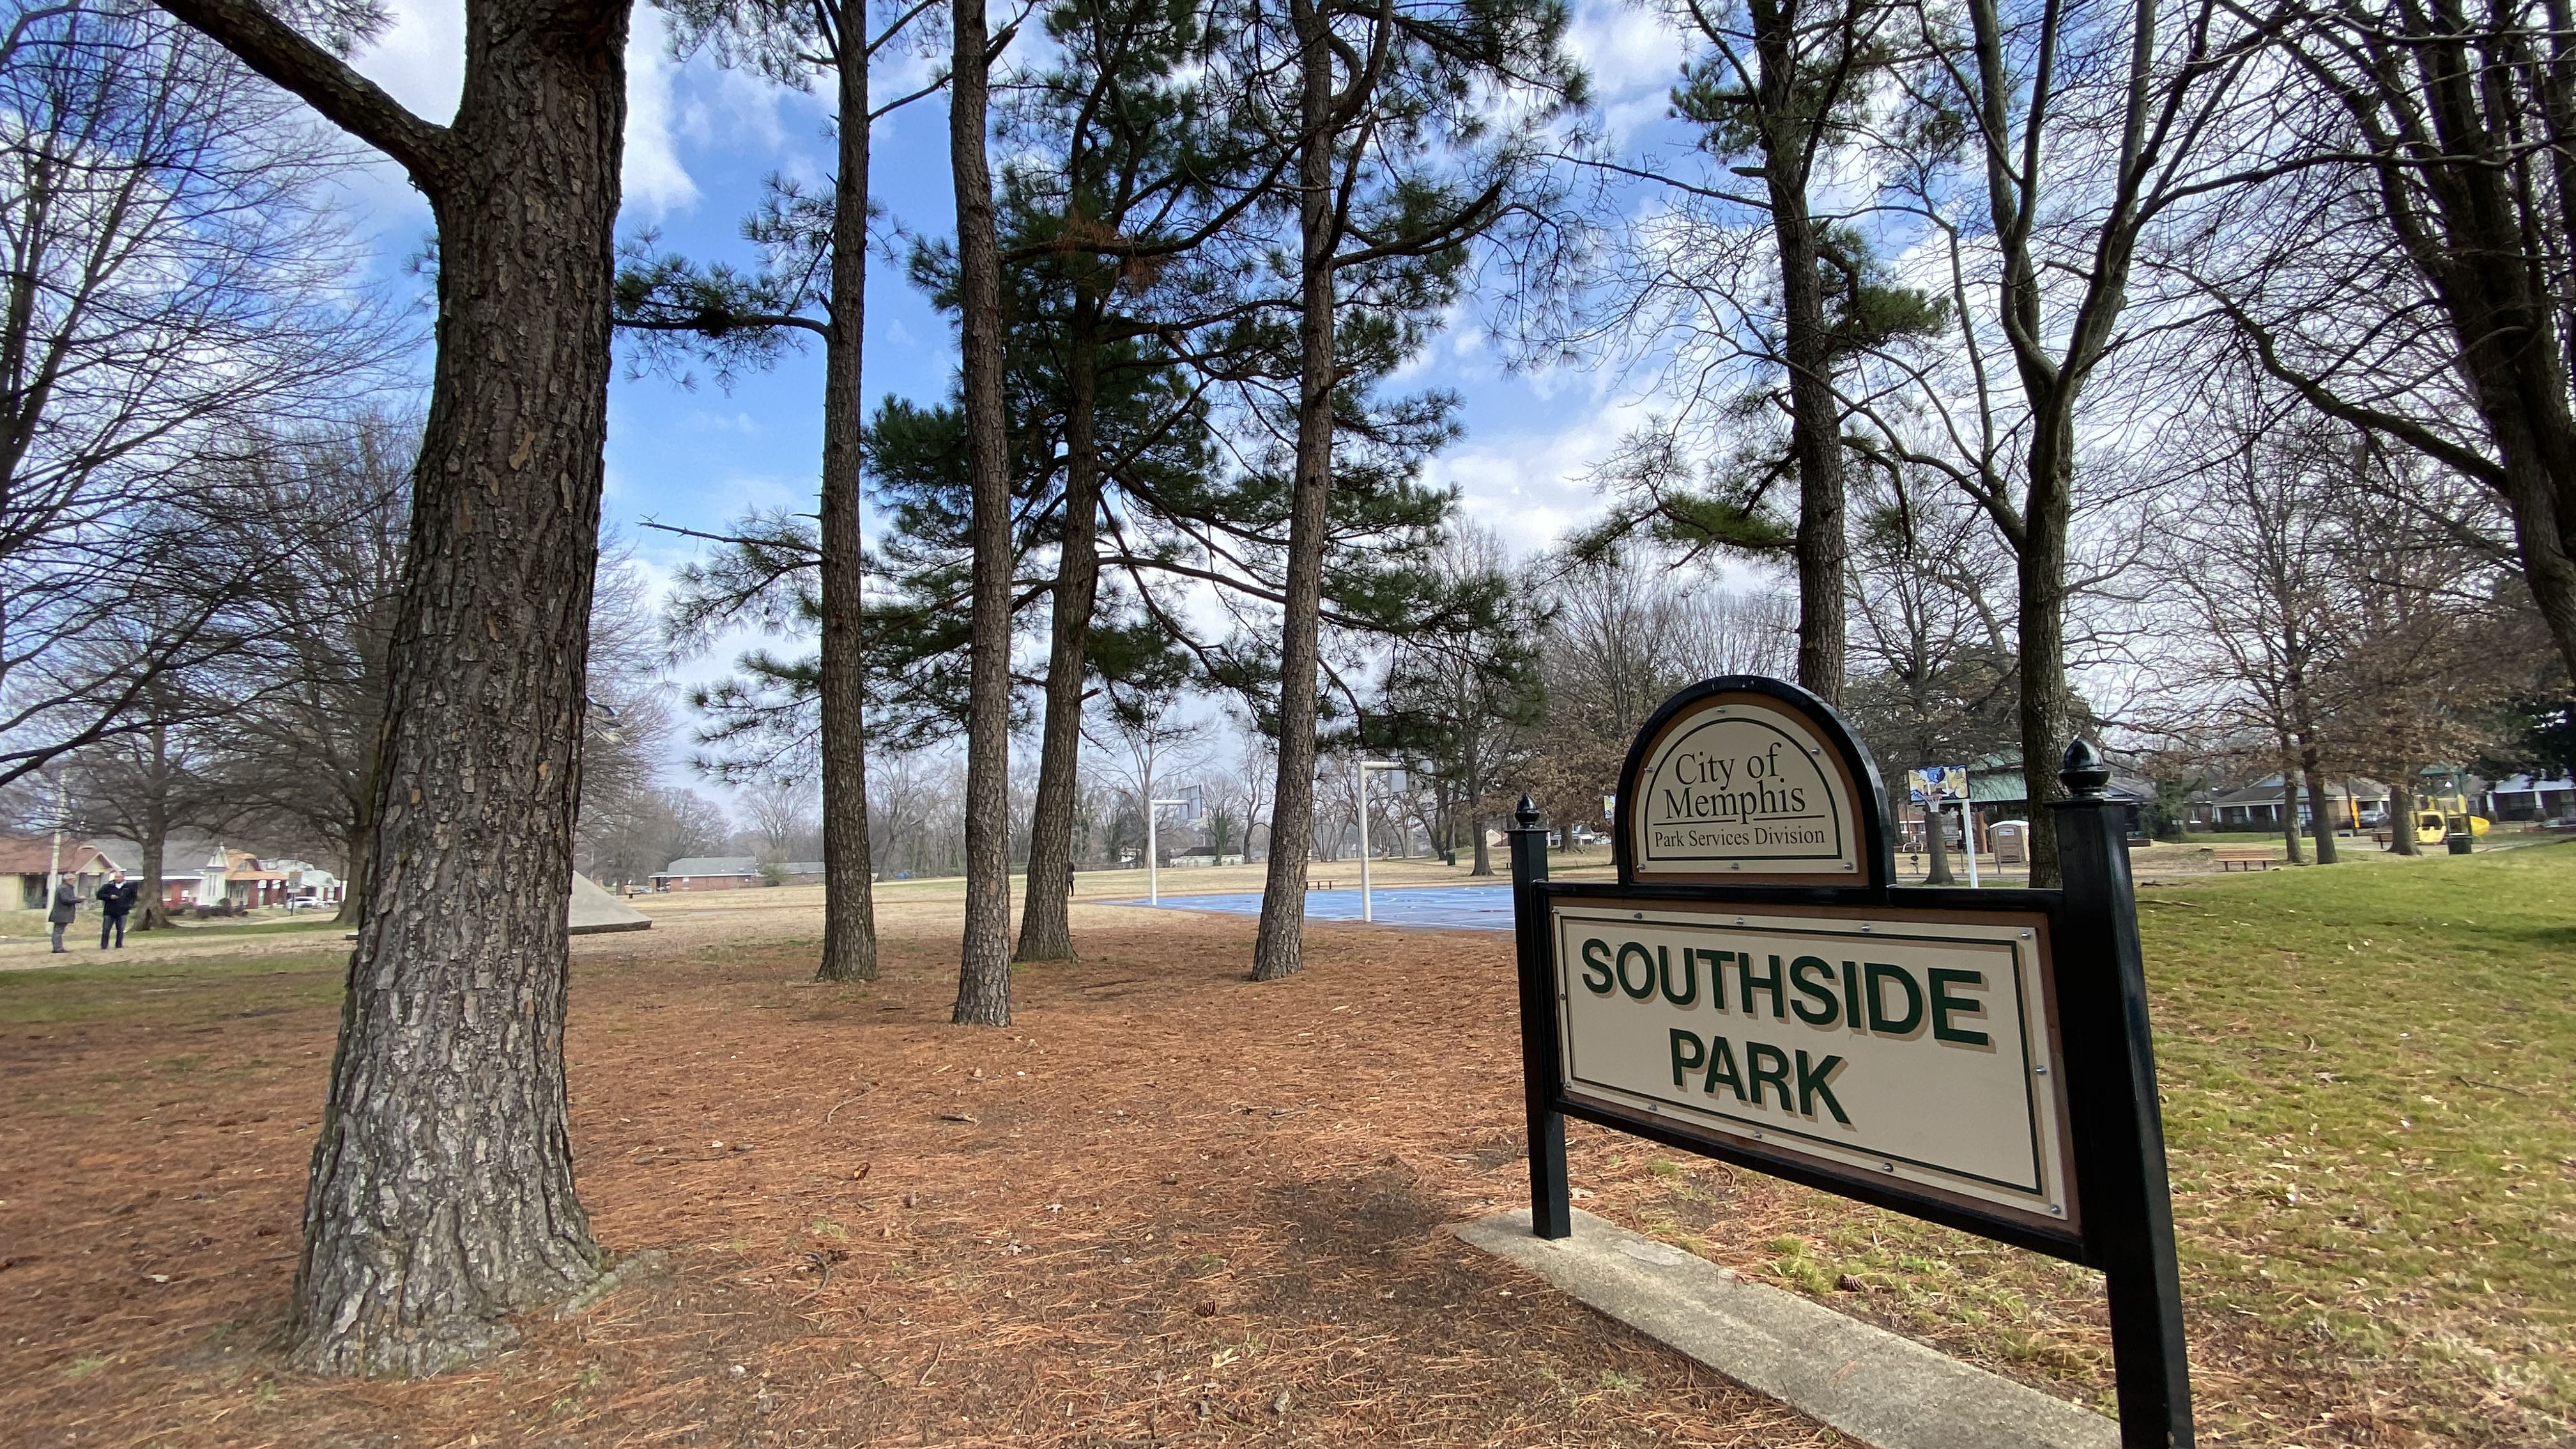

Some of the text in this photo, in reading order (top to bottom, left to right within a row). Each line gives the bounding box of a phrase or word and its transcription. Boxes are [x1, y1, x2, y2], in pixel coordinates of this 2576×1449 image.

[1675, 742, 1782, 791] City of
[1663, 778, 1805, 825] Memphis
[1655, 825, 1825, 847] Park Services Division
[1582, 939, 1988, 1046] SOUTHSIDE
[1669, 1028, 1851, 1124] PARK
